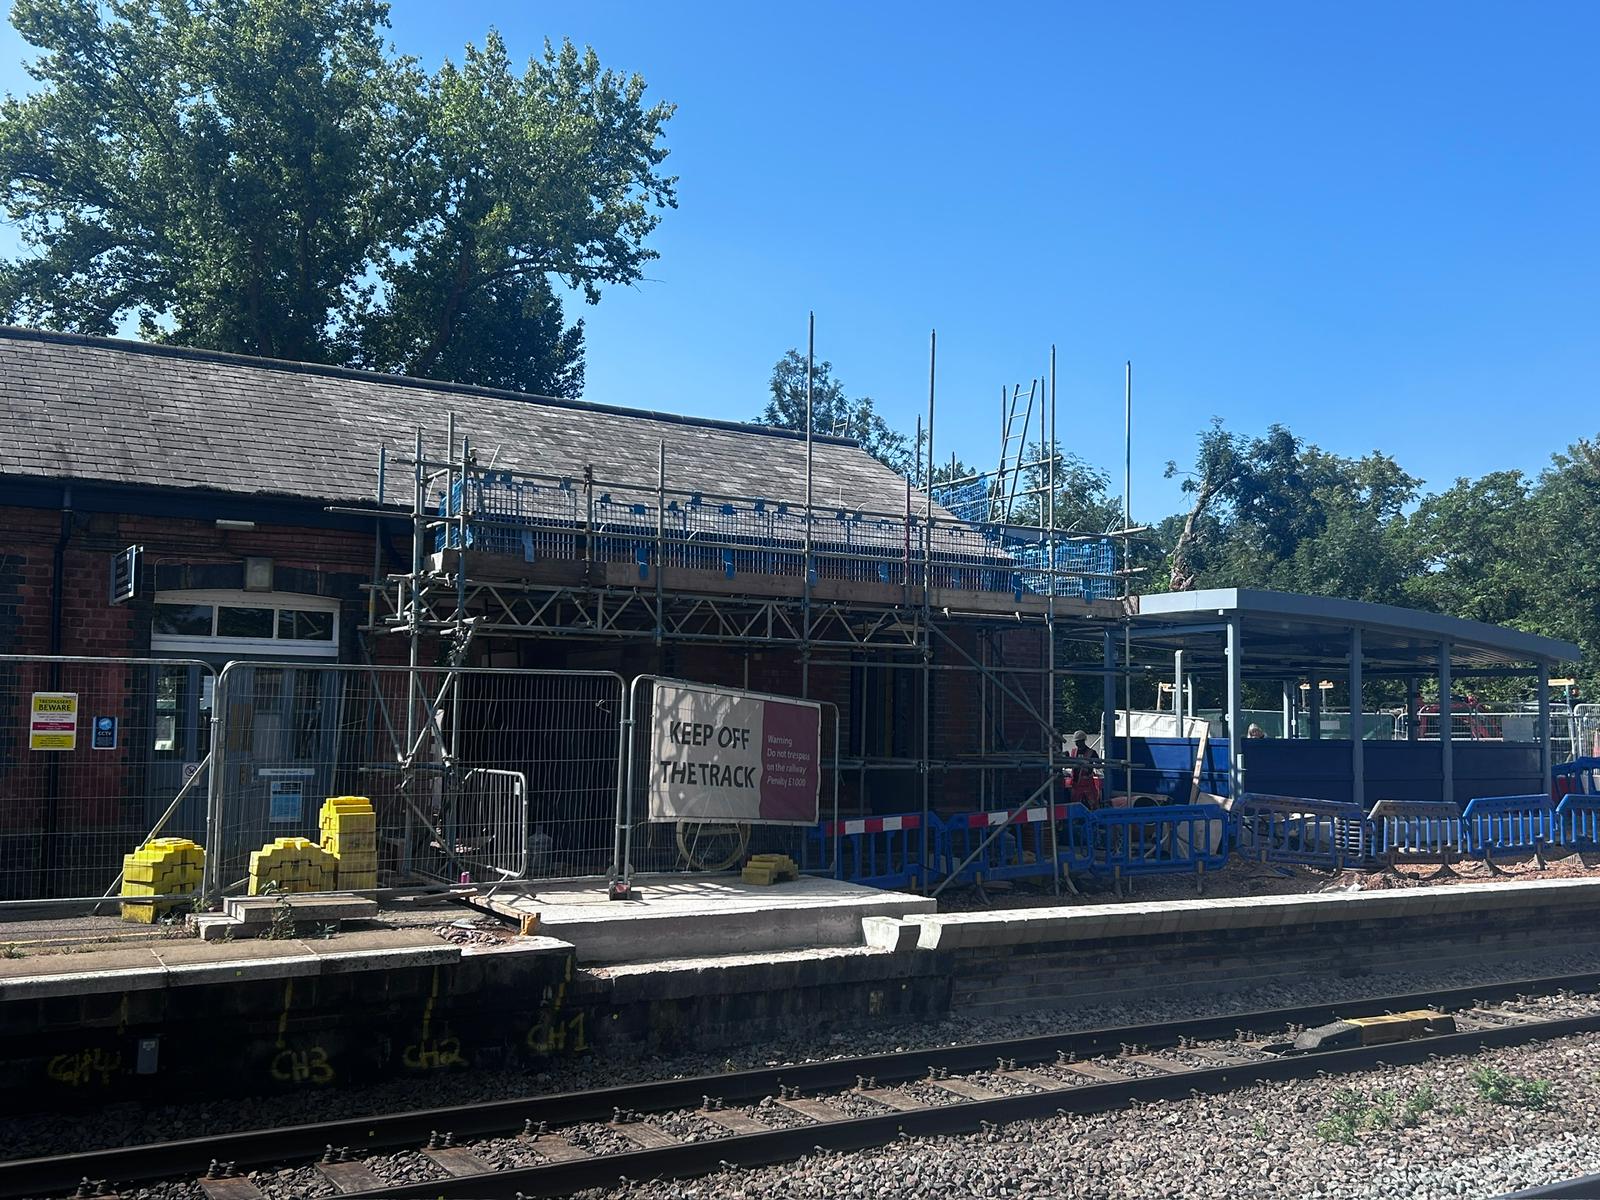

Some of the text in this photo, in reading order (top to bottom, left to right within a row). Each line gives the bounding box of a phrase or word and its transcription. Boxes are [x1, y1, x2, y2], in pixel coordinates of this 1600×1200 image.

[38, 704, 71, 712] BEWARE
[670, 721, 750, 750] KEEP OFF
[767, 735, 792, 747] Warning
[767, 748, 810, 761] Do not trespass
[660, 760, 756, 788] THE TRACK
[775, 763, 785, 771] the
[786, 764, 807, 775] railway
[767, 776, 787, 788] Penalty
[527, 1012, 589, 1052] CH1
[402, 1037, 470, 1069] CH2
[271, 1046, 336, 1084] CH3
